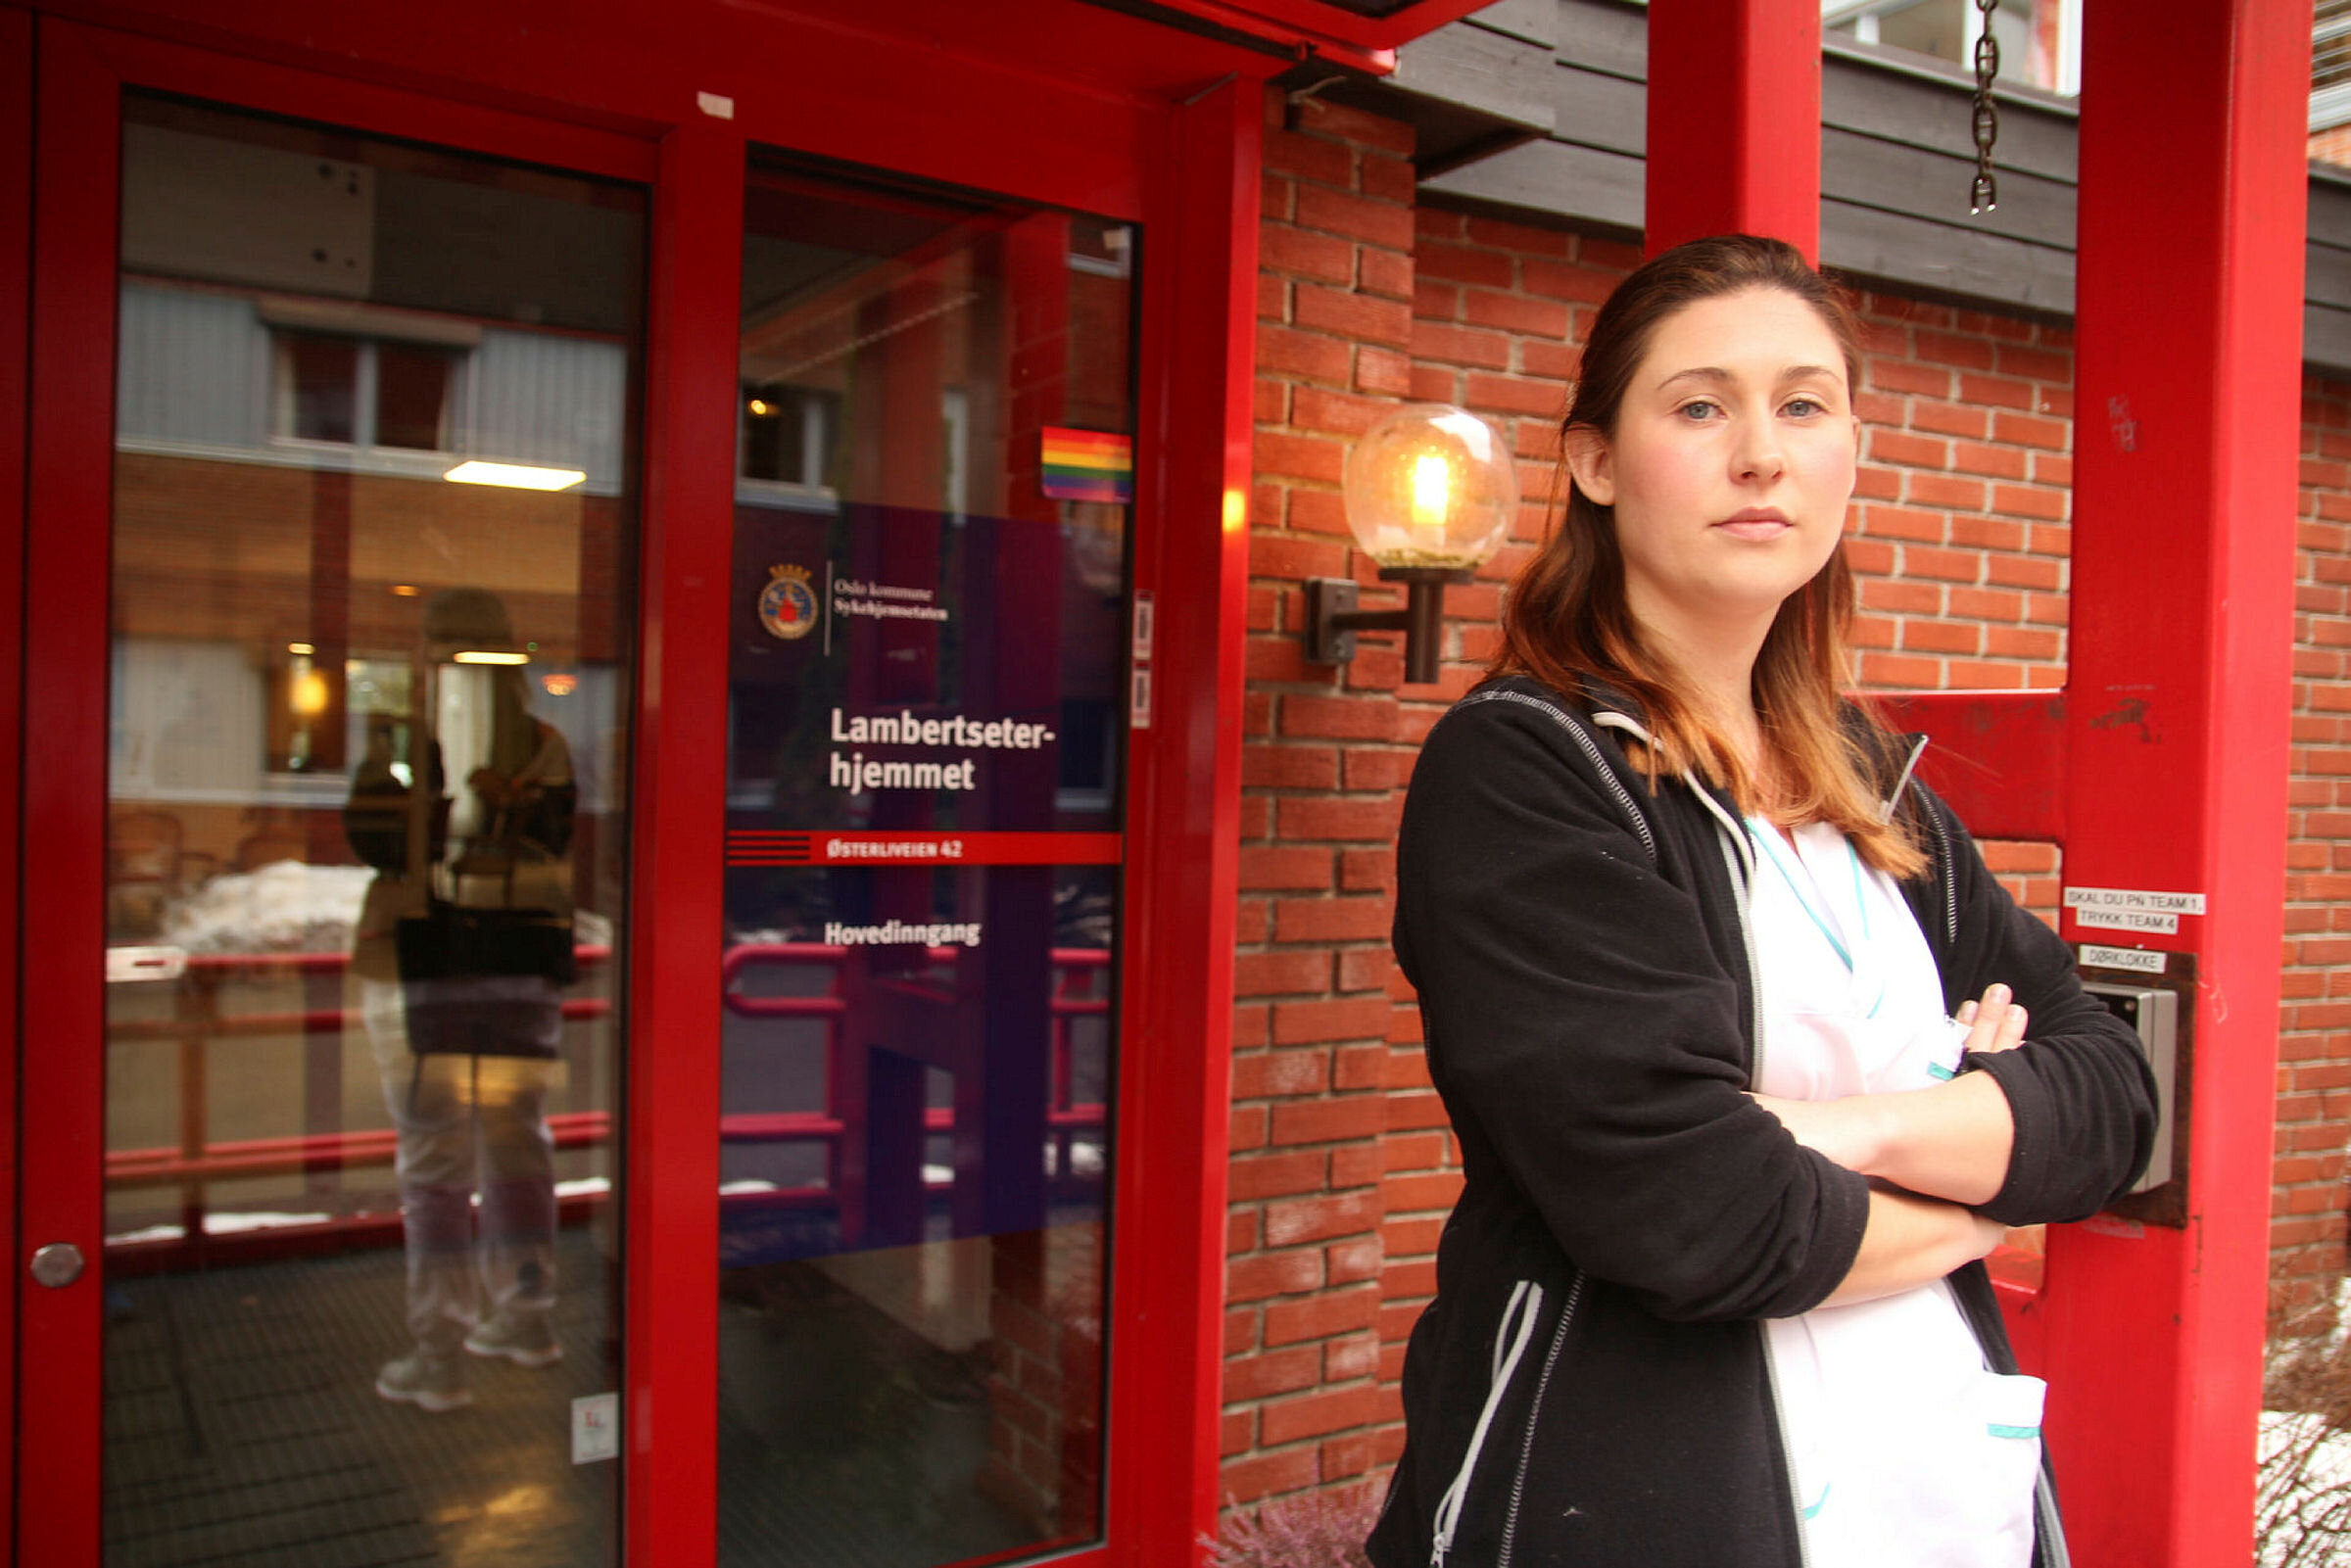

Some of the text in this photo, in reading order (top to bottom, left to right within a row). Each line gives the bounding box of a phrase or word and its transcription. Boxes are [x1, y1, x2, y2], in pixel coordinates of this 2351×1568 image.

[834, 579, 934, 602] Oslo kommune
[831, 707, 1056, 748] Lambertseter-
[829, 751, 976, 795] hjemmet
[939, 840, 963, 858] 42
[2068, 891, 2100, 904] SKAL
[2104, 893, 2123, 906] DU
[2149, 896, 2187, 911] TEAM
[2081, 909, 2176, 929] TRYKK TEAM 4
[824, 920, 982, 948] Hovedinngang
